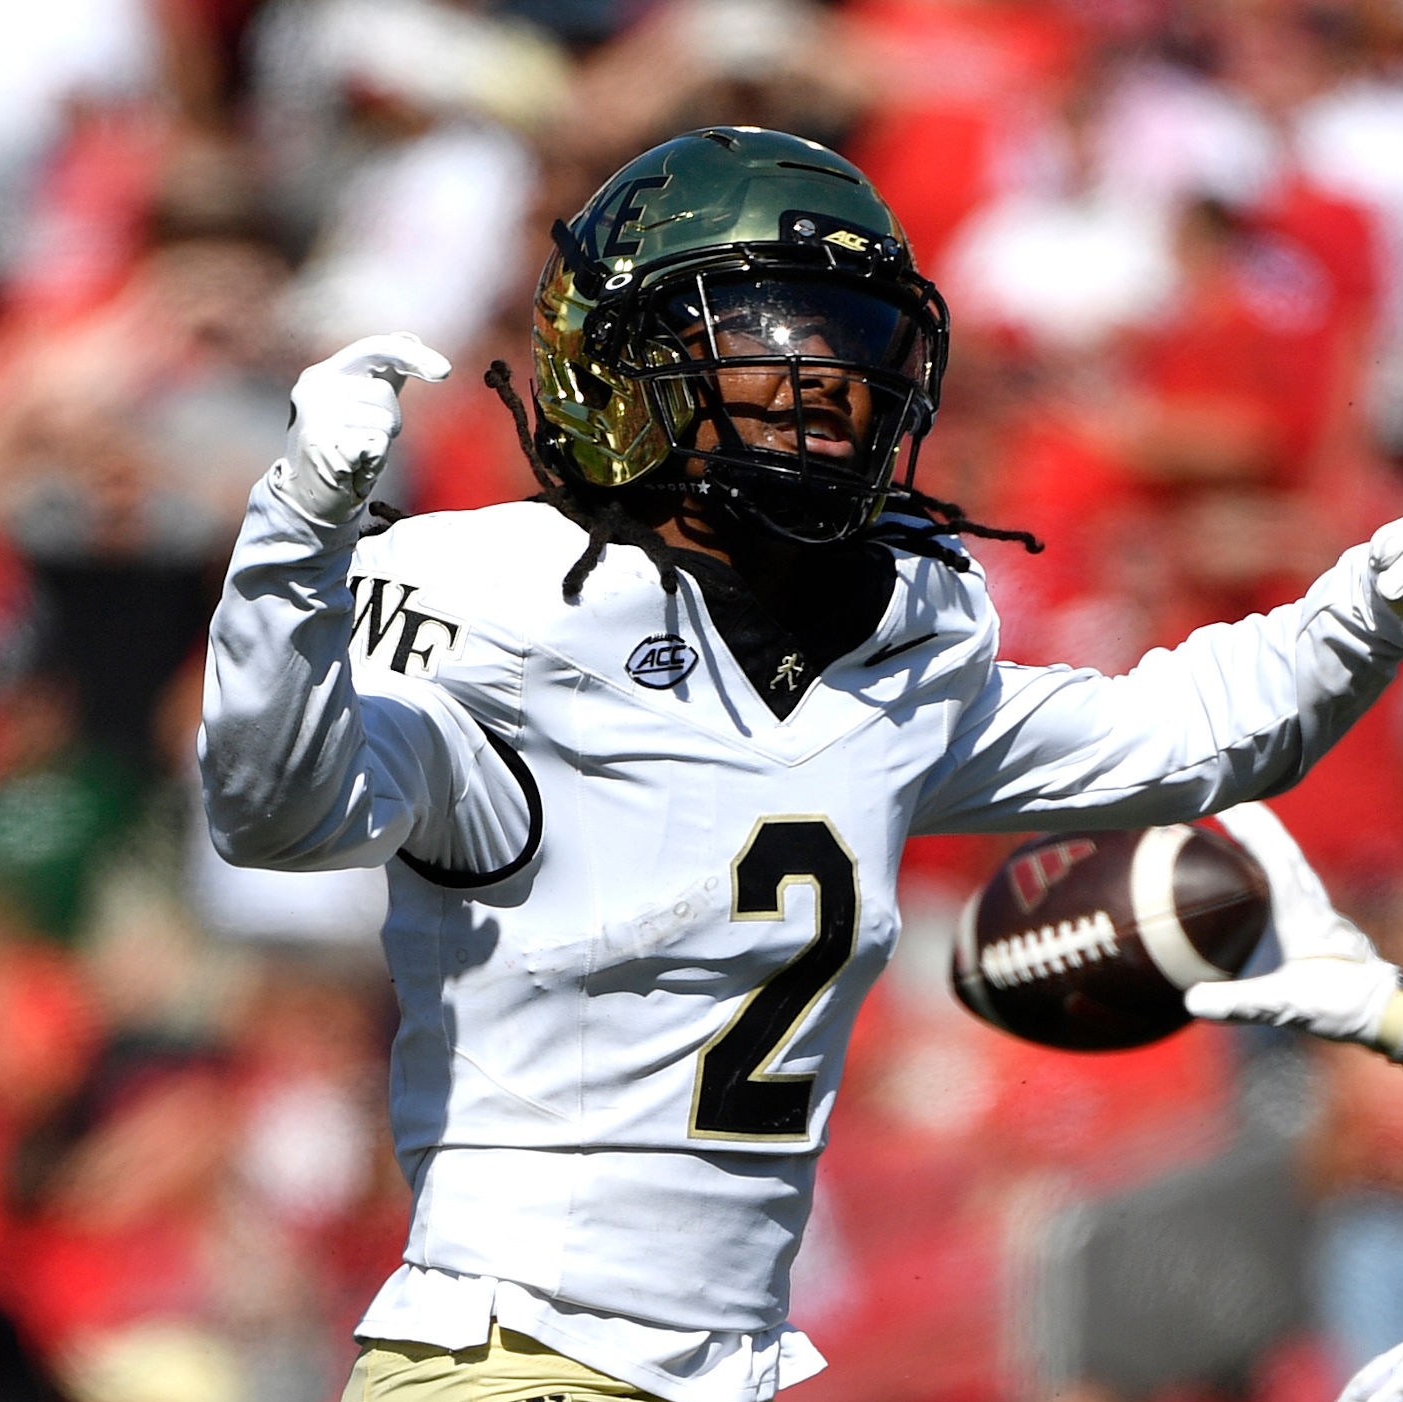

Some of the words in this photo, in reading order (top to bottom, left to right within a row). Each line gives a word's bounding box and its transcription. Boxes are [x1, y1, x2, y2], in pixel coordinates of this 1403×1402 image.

[821, 230, 870, 252] ACC
[347, 575, 461, 675] WF
[636, 644, 687, 671] ACC
[687, 814, 861, 1143] 2
